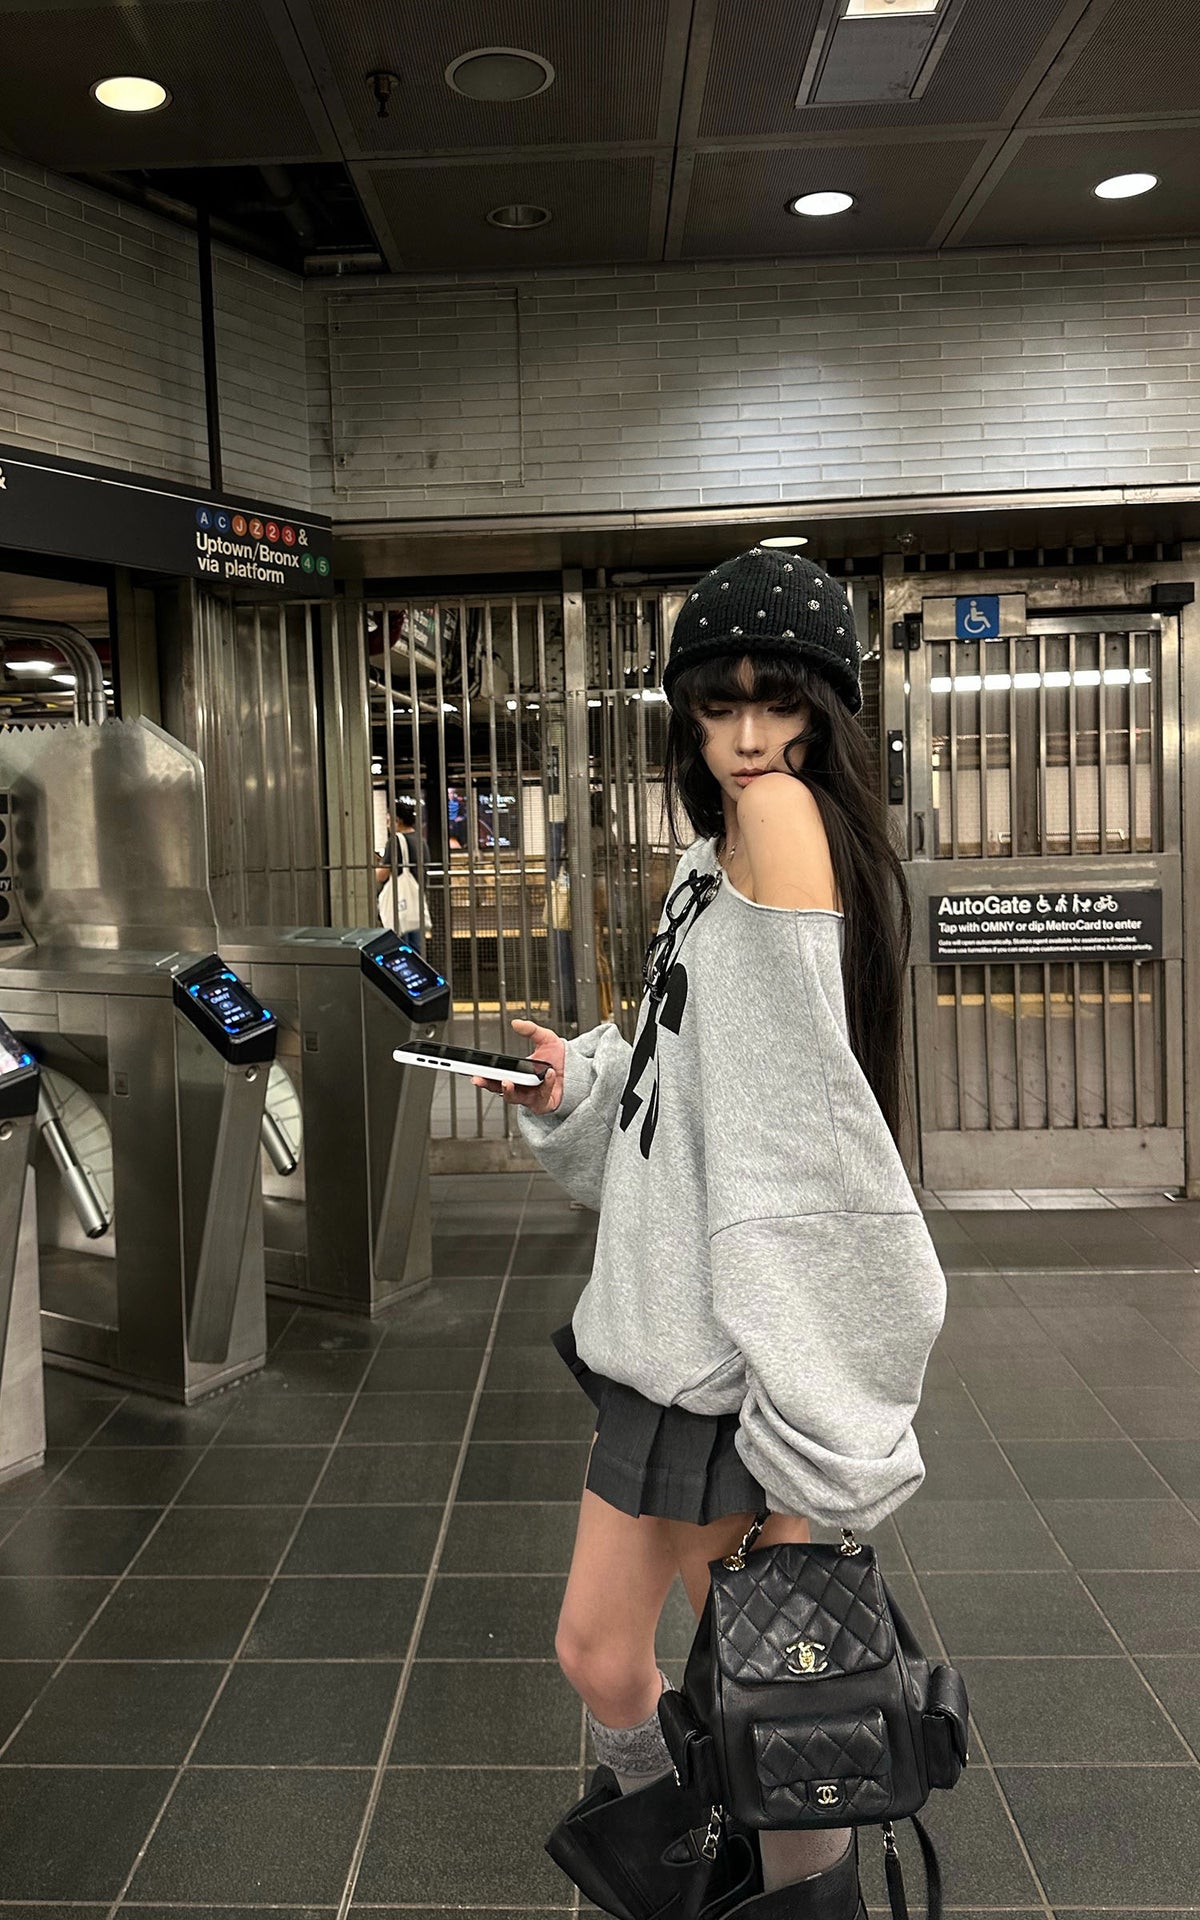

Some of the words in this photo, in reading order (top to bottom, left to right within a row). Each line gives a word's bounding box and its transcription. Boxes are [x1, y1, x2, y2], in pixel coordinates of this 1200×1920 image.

[200, 512, 209, 525] A
[218, 516, 226, 529] C
[236, 520, 244, 532] J
[253, 522, 261, 535] Z
[269, 525, 277, 538] 2
[285, 530, 292, 542] 3
[298, 528, 308, 546] &
[196, 531, 300, 569] Uptown/Bronx
[303, 558, 311, 569] 4
[319, 560, 327, 573] 5
[197, 554, 220, 574] via
[225, 559, 285, 585] platform
[938, 895, 1031, 915] AutoGate
[938, 922, 957, 934] Tap
[958, 921, 980, 933] with
[981, 920, 1015, 933] OMNY
[1015, 922, 1027, 932] or
[1028, 920, 1045, 933] dip
[1045, 919, 1101, 931] MetroCard
[1102, 919, 1114, 930] to
[1114, 919, 1142, 930] enter
